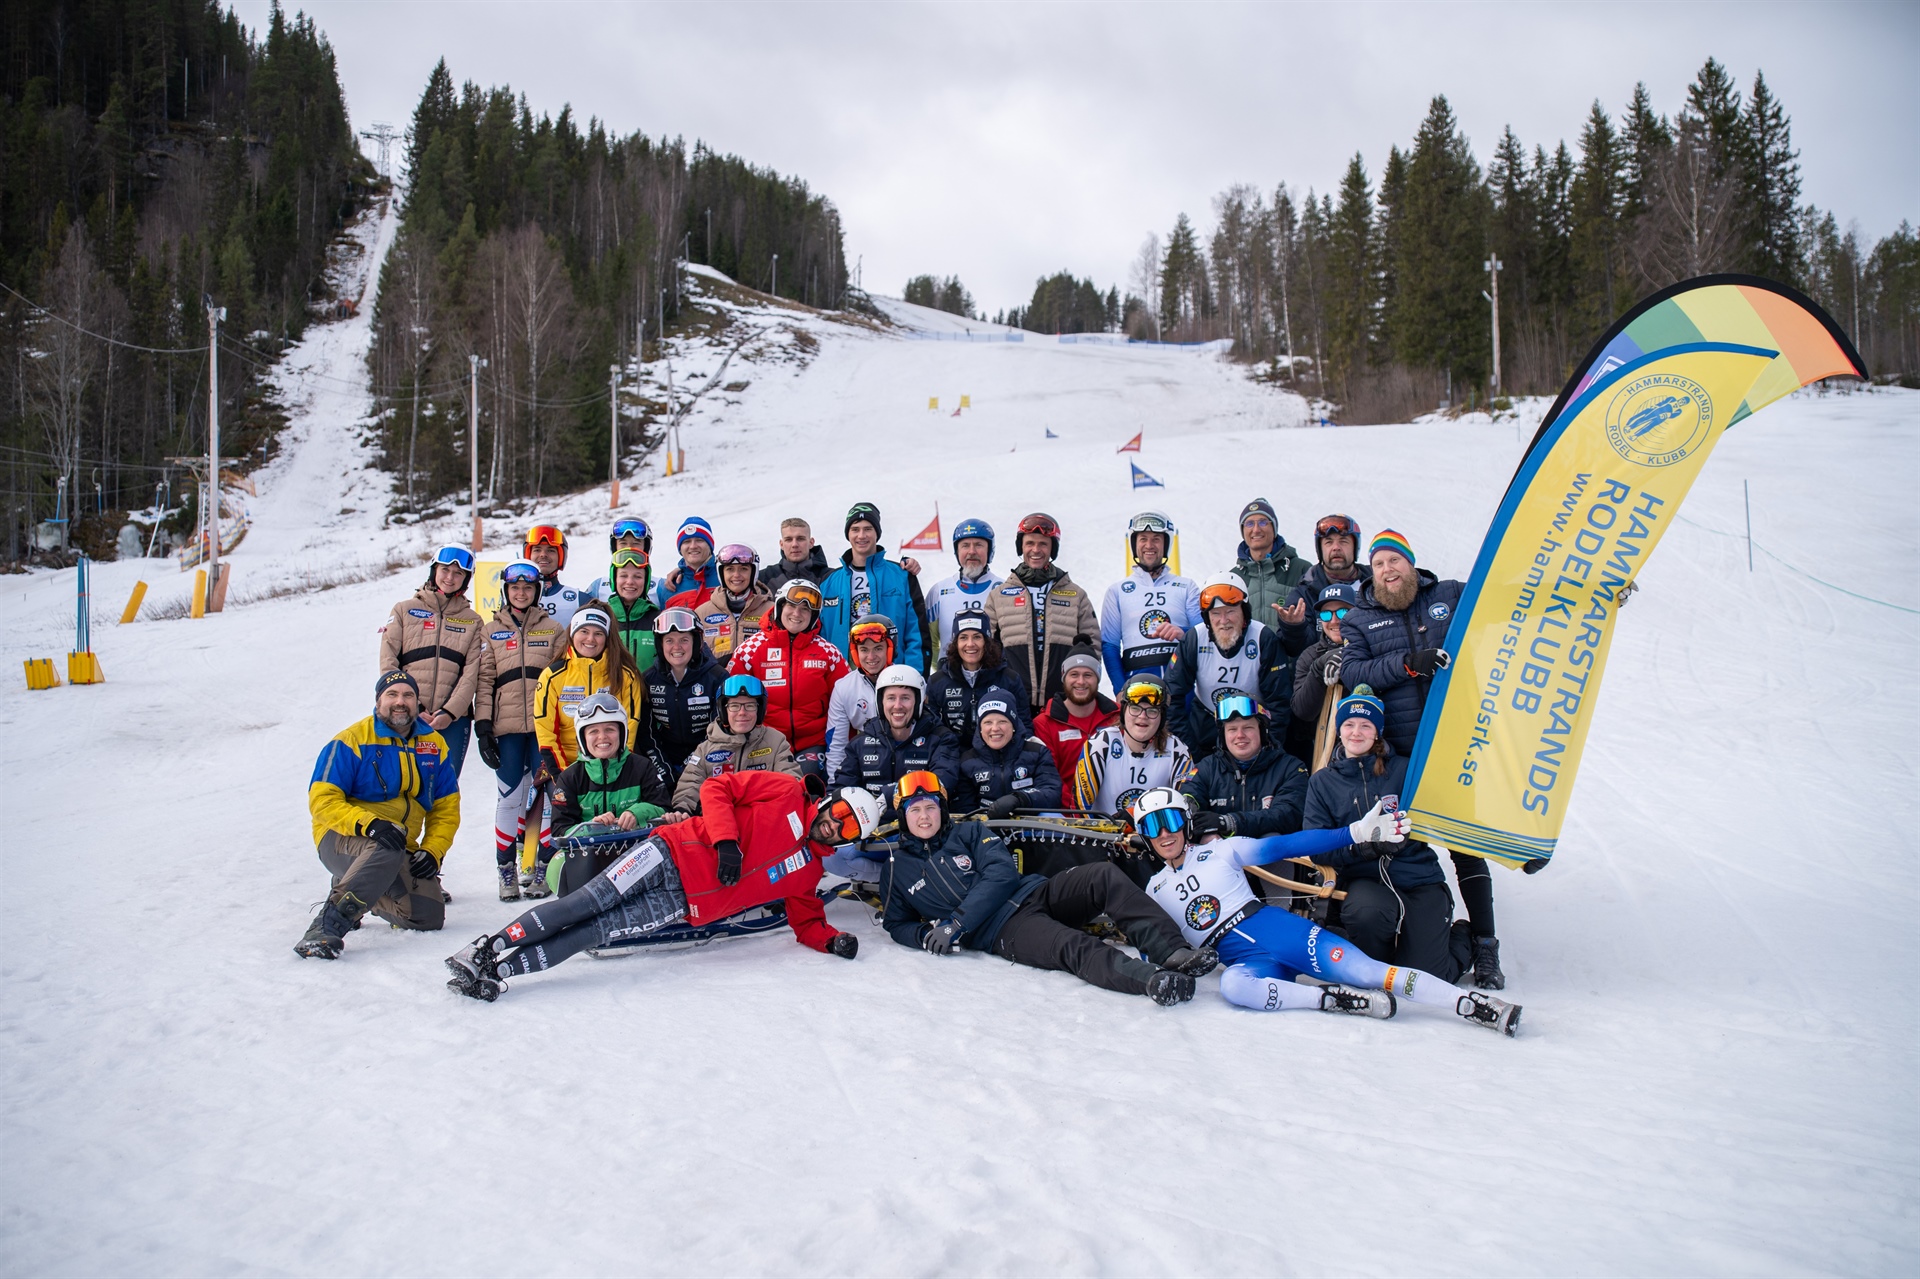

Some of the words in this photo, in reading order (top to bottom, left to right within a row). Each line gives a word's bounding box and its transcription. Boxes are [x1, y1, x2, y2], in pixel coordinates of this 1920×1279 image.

[1627, 377, 1710, 421] HAMMARSTRANDS
[1609, 425, 1631, 458] RODEL
[1648, 449, 1687, 465] KLUBB
[1144, 592, 1166, 607] 25
[1325, 588, 1341, 598] HH
[1512, 478, 1631, 715] RODELKLUBB
[1368, 620, 1388, 630] CRAFT
[1459, 471, 1592, 787] www.hammarstrandsrk.se
[1522, 491, 1664, 816] HAMMARSTRANDS
[1217, 666, 1240, 684] 27
[650, 685, 666, 693] EA7
[945, 688, 962, 696] EA7
[649, 755, 666, 776] Audi
[974, 771, 990, 780] EA7
[1129, 766, 1148, 785] 16
[1080, 772, 1092, 805] Lufthansa
[616, 846, 654, 877] INTERSPORT
[1175, 874, 1200, 901] 30
[609, 908, 684, 938] STADLER
[1385, 967, 1397, 991] PIRELLI
[1404, 971, 1418, 996] FORST
